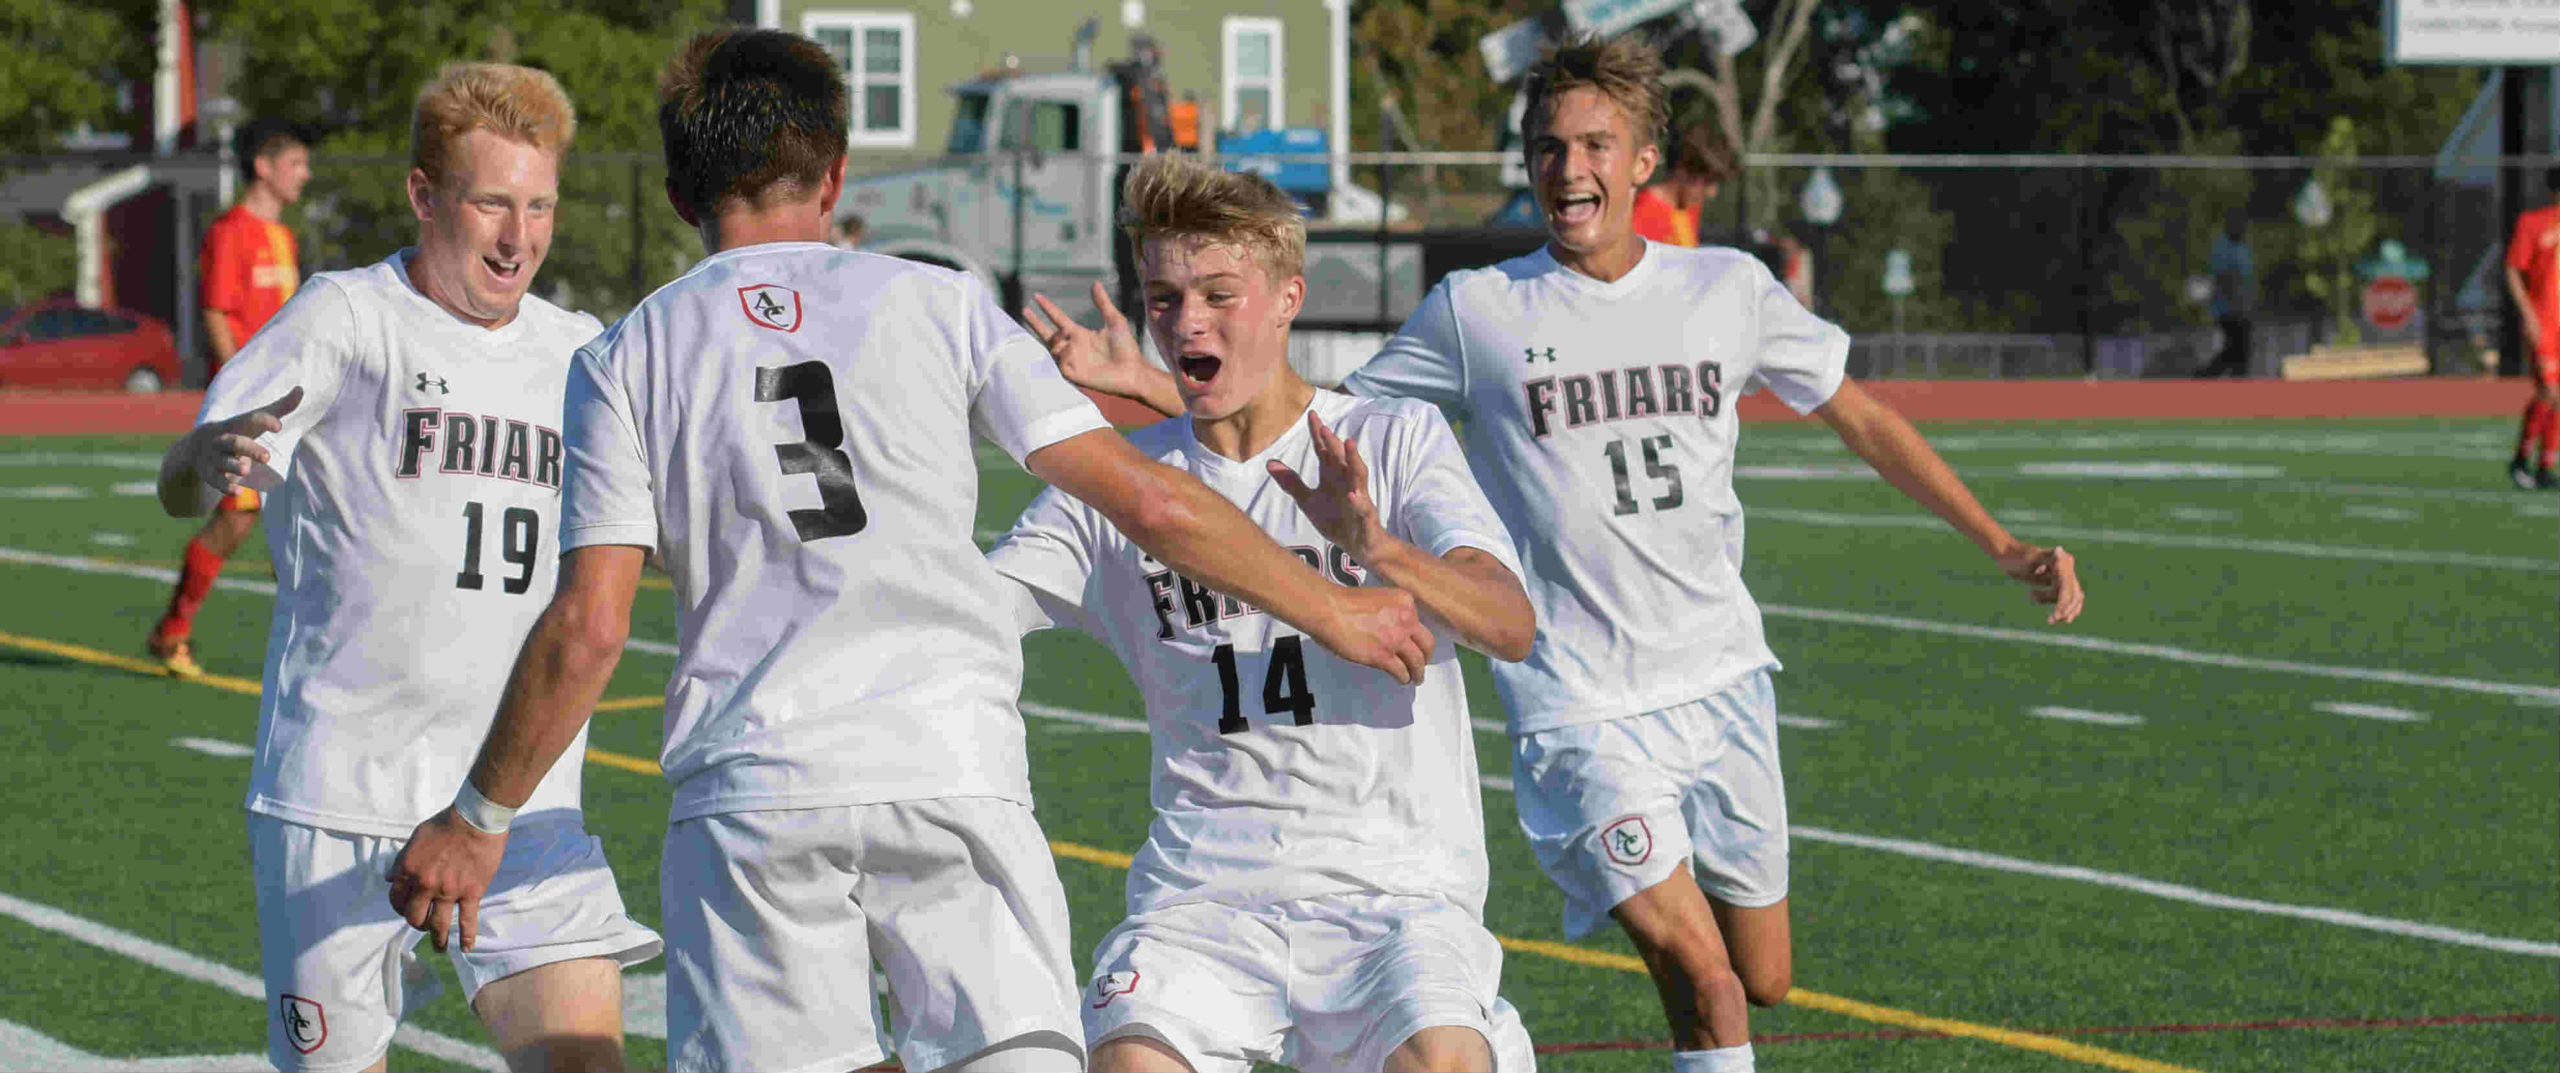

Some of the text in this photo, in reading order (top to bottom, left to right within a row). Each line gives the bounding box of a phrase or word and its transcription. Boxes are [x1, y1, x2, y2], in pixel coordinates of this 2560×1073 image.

[754, 290, 790, 327] AC
[1523, 360, 1721, 440] FRIARS
[395, 406, 562, 492] FRIAR
[753, 360, 868, 543] 3
[1603, 434, 1683, 516] 15
[456, 500, 540, 594] 19
[1211, 634, 1316, 735] 14
